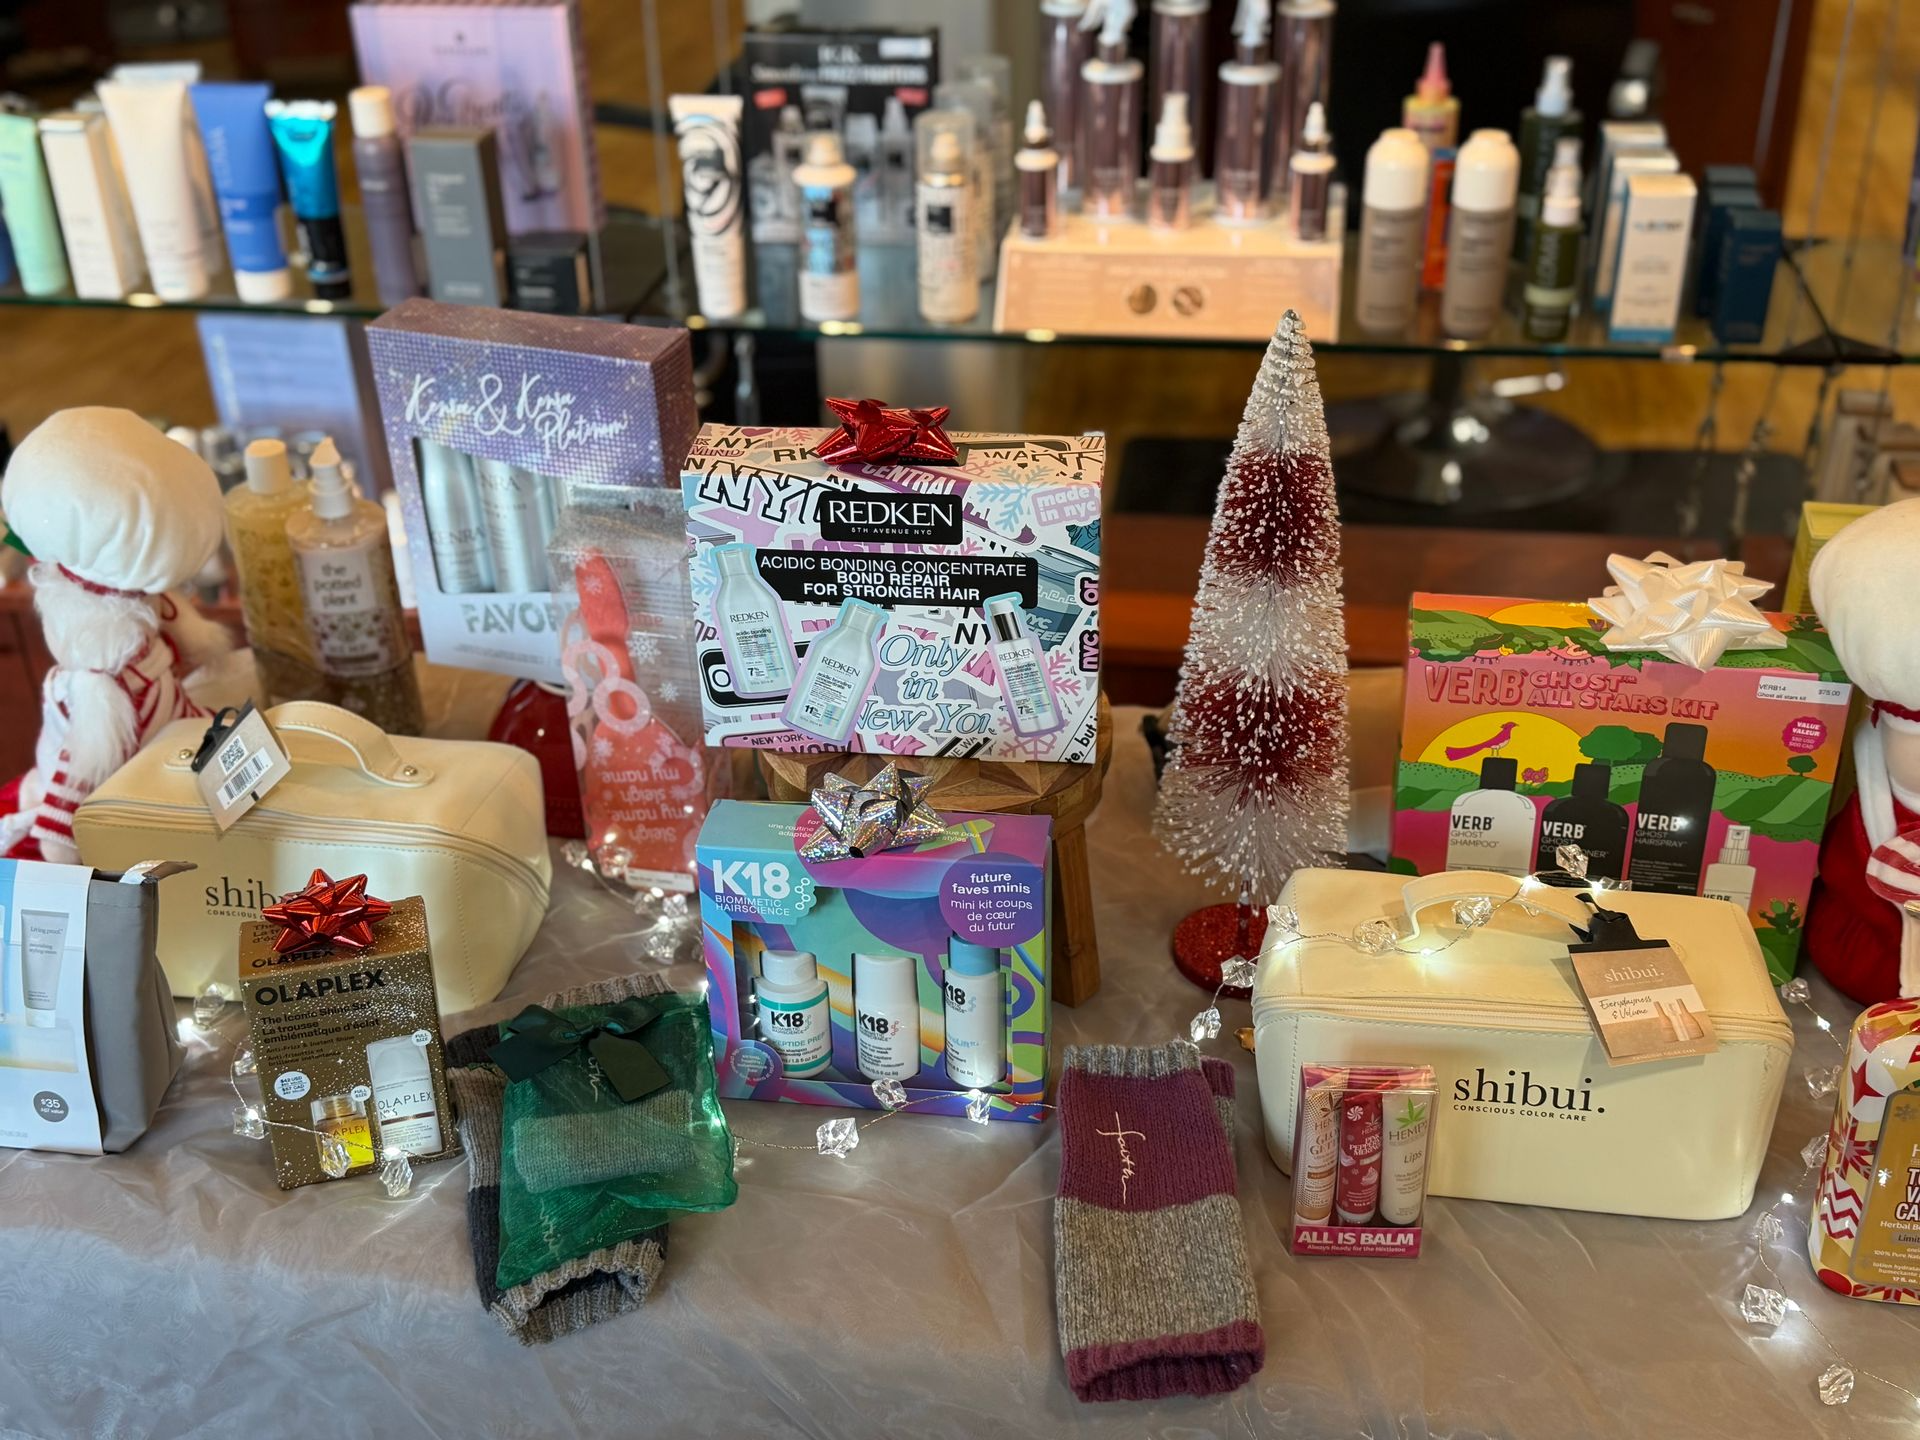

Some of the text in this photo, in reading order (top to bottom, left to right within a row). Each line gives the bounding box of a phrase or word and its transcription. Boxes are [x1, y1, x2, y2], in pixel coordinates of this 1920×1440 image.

[474, 373, 526, 437] &
[1037, 486, 1090, 507] made
[829, 500, 953, 527] REDKEN
[1040, 510, 1058, 523] in
[321, 563, 347, 577] the
[760, 556, 1027, 577] ACIDIC BONDING CONCENTRATE
[836, 572, 950, 588] BOND REPAIR
[803, 583, 980, 600] FOR STRONGER HAIR
[729, 610, 769, 623] REDKEN
[880, 632, 972, 677] Only
[998, 648, 1035, 662] REDKEN
[821, 656, 860, 677] REDKEN
[902, 671, 938, 700] in
[1425, 664, 1525, 705] VERB
[1526, 689, 1719, 720] ALL STARS KIT
[1792, 728, 1821, 737] VALEUR
[1797, 721, 1821, 730] VALUE
[750, 733, 804, 746] NEW YORK
[1452, 815, 1492, 831] VERB
[1543, 820, 1585, 839] VERB
[1638, 813, 1681, 832] VERB
[1450, 830, 1484, 838] GHOST
[1541, 836, 1575, 845] GHOST
[1635, 830, 1668, 838] GHOST
[712, 859, 790, 899] K18
[970, 873, 1012, 884] future
[952, 882, 1031, 894] faves minis
[715, 894, 782, 908] BIOMIMETIC
[950, 900, 1033, 910] mini kit coups
[207, 909, 259, 919] CONSCIOUS
[716, 903, 790, 916] HAIRSCIENCE
[967, 911, 983, 921] de
[969, 921, 1015, 932] du futur
[255, 968, 386, 1006] OLAPLEX
[260, 1016, 282, 1025] The
[284, 1011, 318, 1022] Iconic
[319, 1006, 351, 1017] Shine
[771, 1011, 804, 1028] K18
[858, 1009, 889, 1034] K18
[262, 1020, 319, 1035] La trousse
[263, 1018, 380, 1044] emblématique d'éclat
[41, 1098, 61, 1109] $35
[377, 1093, 433, 1110] OLAPLEX
[1453, 1104, 1587, 1121] CONSCIOUS COLOR CARE
[1096, 1112, 1146, 1205] faith
[1403, 1150, 1423, 1164] Lips
[1880, 1221, 1911, 1230] Herbal
[1298, 1231, 1414, 1246] ALL IS BALM
